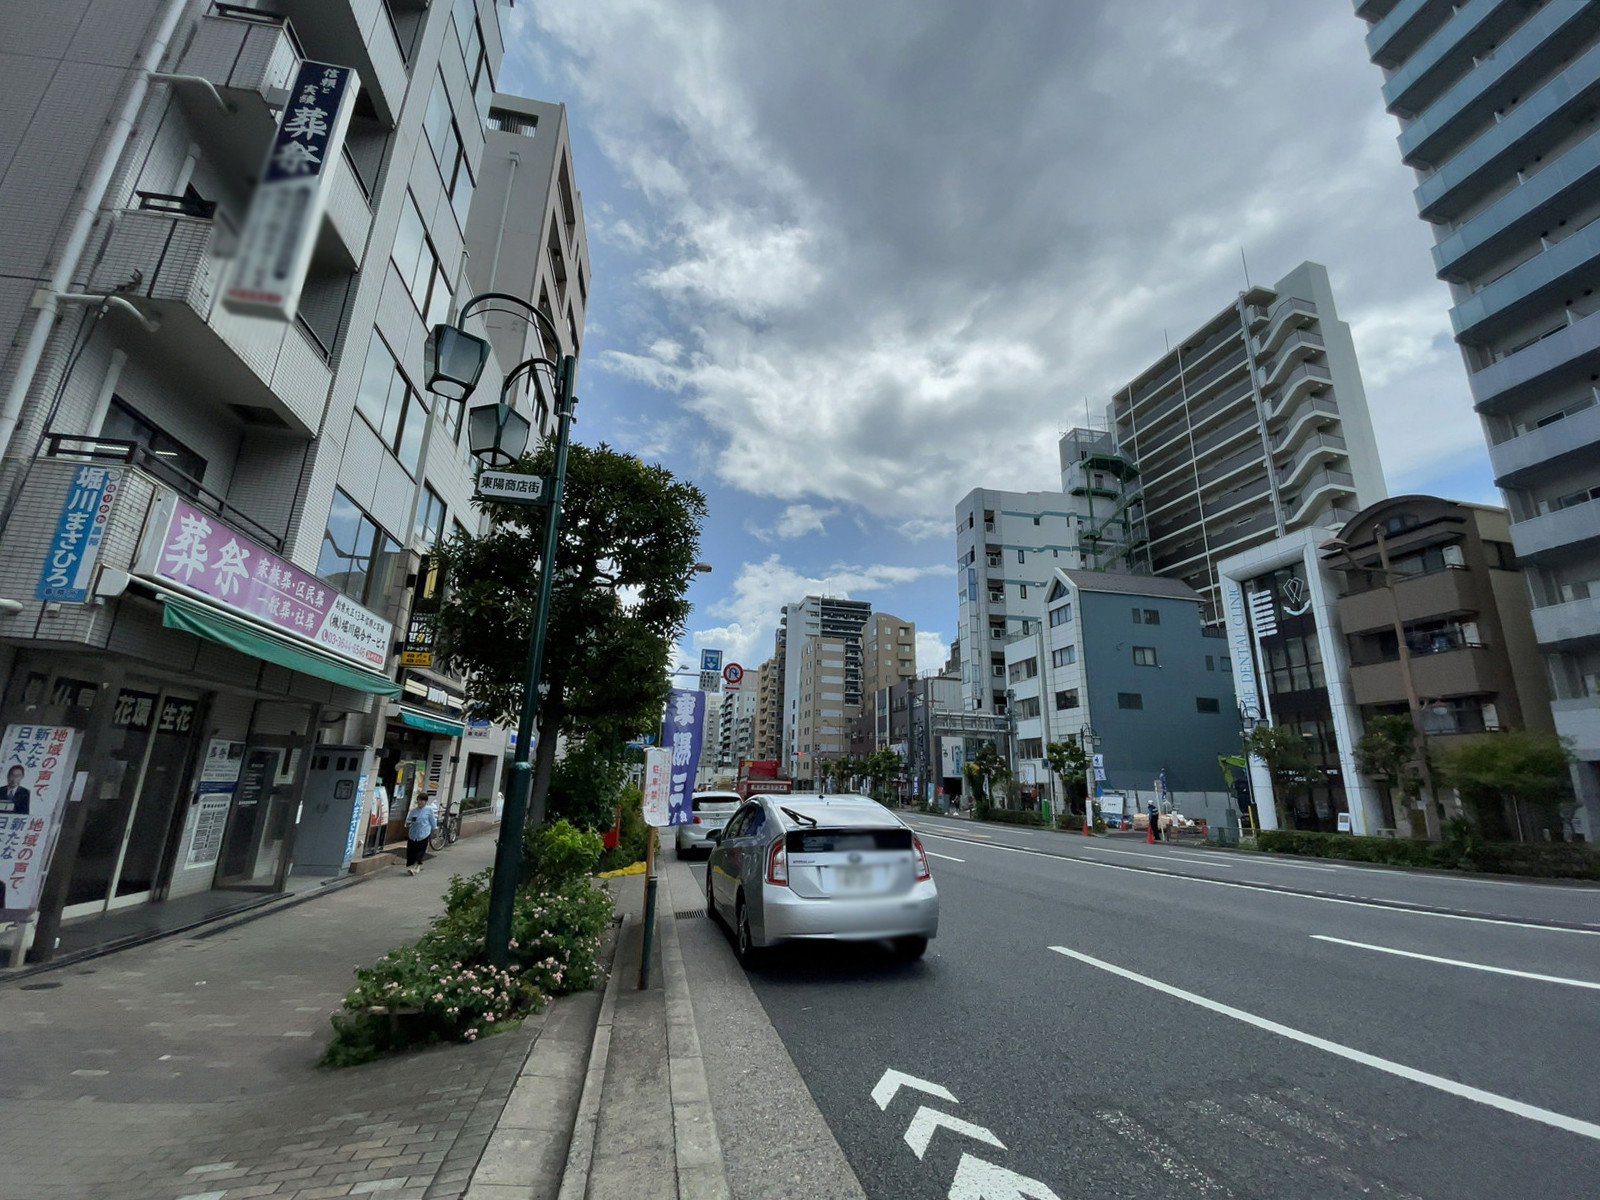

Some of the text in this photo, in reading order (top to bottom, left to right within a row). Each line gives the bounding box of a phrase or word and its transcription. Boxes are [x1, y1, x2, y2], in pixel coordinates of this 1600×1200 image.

[274, 106, 329, 175] 葬祭
[481, 476, 540, 494] 東陽商店街
[45, 466, 106, 588] 堀川まさひろ
[165, 512, 252, 596] 葬祭
[1228, 585, 1244, 627] CLINIC
[1236, 630, 1253, 684] DENTAL
[159, 702, 193, 732] 生花
[9, 727, 33, 763] 日本へ
[25, 727, 52, 768] 新たな
[33, 728, 68, 802] 地域の声で、
[1, 817, 27, 860] 新たな
[10, 817, 45, 895] 地域の声で、
